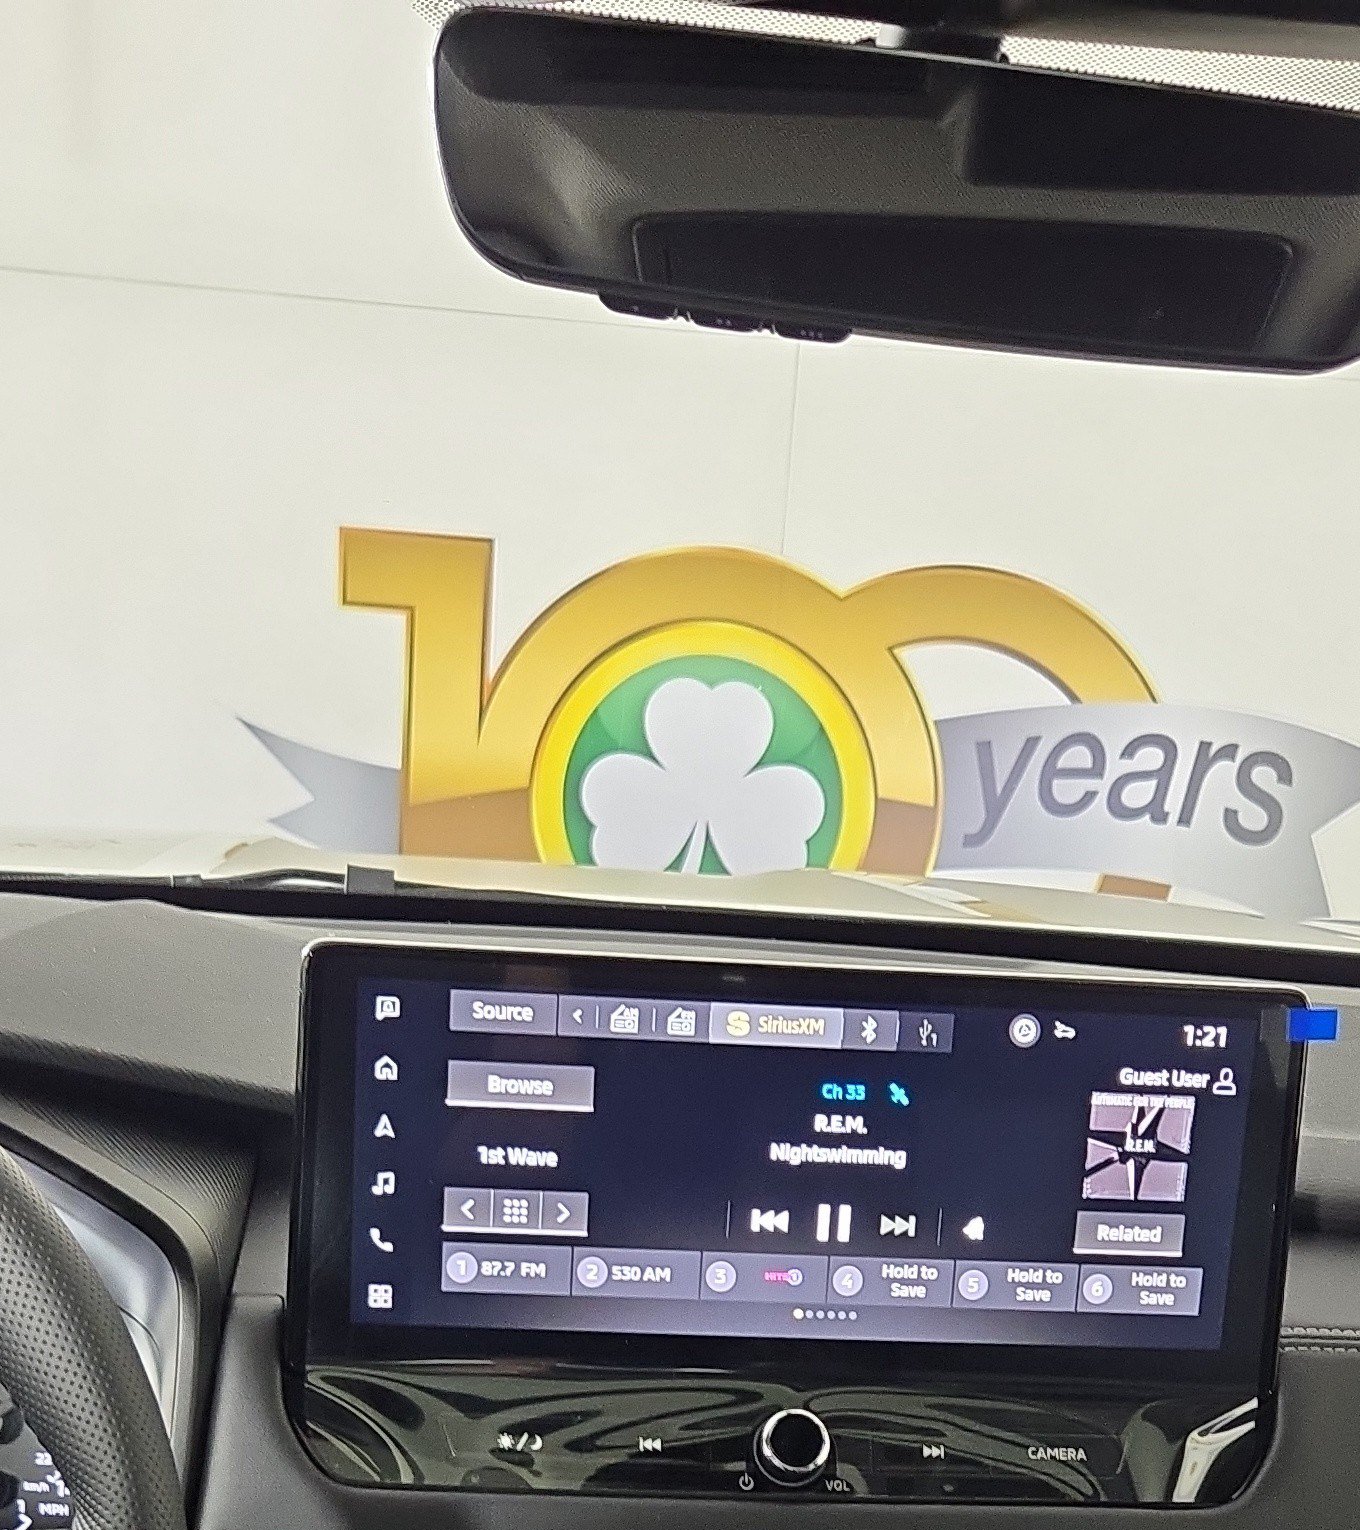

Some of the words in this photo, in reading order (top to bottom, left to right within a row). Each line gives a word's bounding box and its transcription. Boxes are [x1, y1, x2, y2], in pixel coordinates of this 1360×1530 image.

[960, 729, 1294, 849] years
[472, 1001, 534, 1023] Source
[757, 1015, 826, 1036] SiriusXM
[1183, 1025, 1228, 1049] 1:21
[487, 1074, 555, 1097] Browse
[1119, 1067, 1169, 1087] Guest
[1172, 1069, 1210, 1089] User
[821, 1083, 843, 1100] Ch
[813, 1113, 868, 1135] R.E.M.
[477, 1145, 505, 1166] 1st
[507, 1147, 559, 1168] Wave
[770, 1142, 907, 1168] Nightswimming
[1096, 1223, 1162, 1244] Related
[456, 1260, 467, 1276] 1
[480, 1261, 516, 1277] 87.7
[520, 1262, 547, 1278] FM
[586, 1264, 598, 1280] 2
[611, 1265, 641, 1281] 530
[643, 1266, 672, 1283] AM
[715, 1268, 727, 1284] 3
[841, 1274, 853, 1290] 4
[881, 1263, 919, 1282] Hold
[922, 1264, 939, 1282] to
[890, 1282, 927, 1299] Save
[967, 1277, 979, 1294] 5
[1007, 1267, 1044, 1285] Hold
[1046, 1269, 1063, 1285] to
[1091, 1281, 1103, 1297] 6
[1131, 1271, 1168, 1289] Hold
[1170, 1273, 1187, 1289] to
[1016, 1286, 1052, 1303] Save
[1139, 1289, 1175, 1306] Save
[1027, 1445, 1088, 1462] CAMERA
[825, 1479, 851, 1492] VOL
